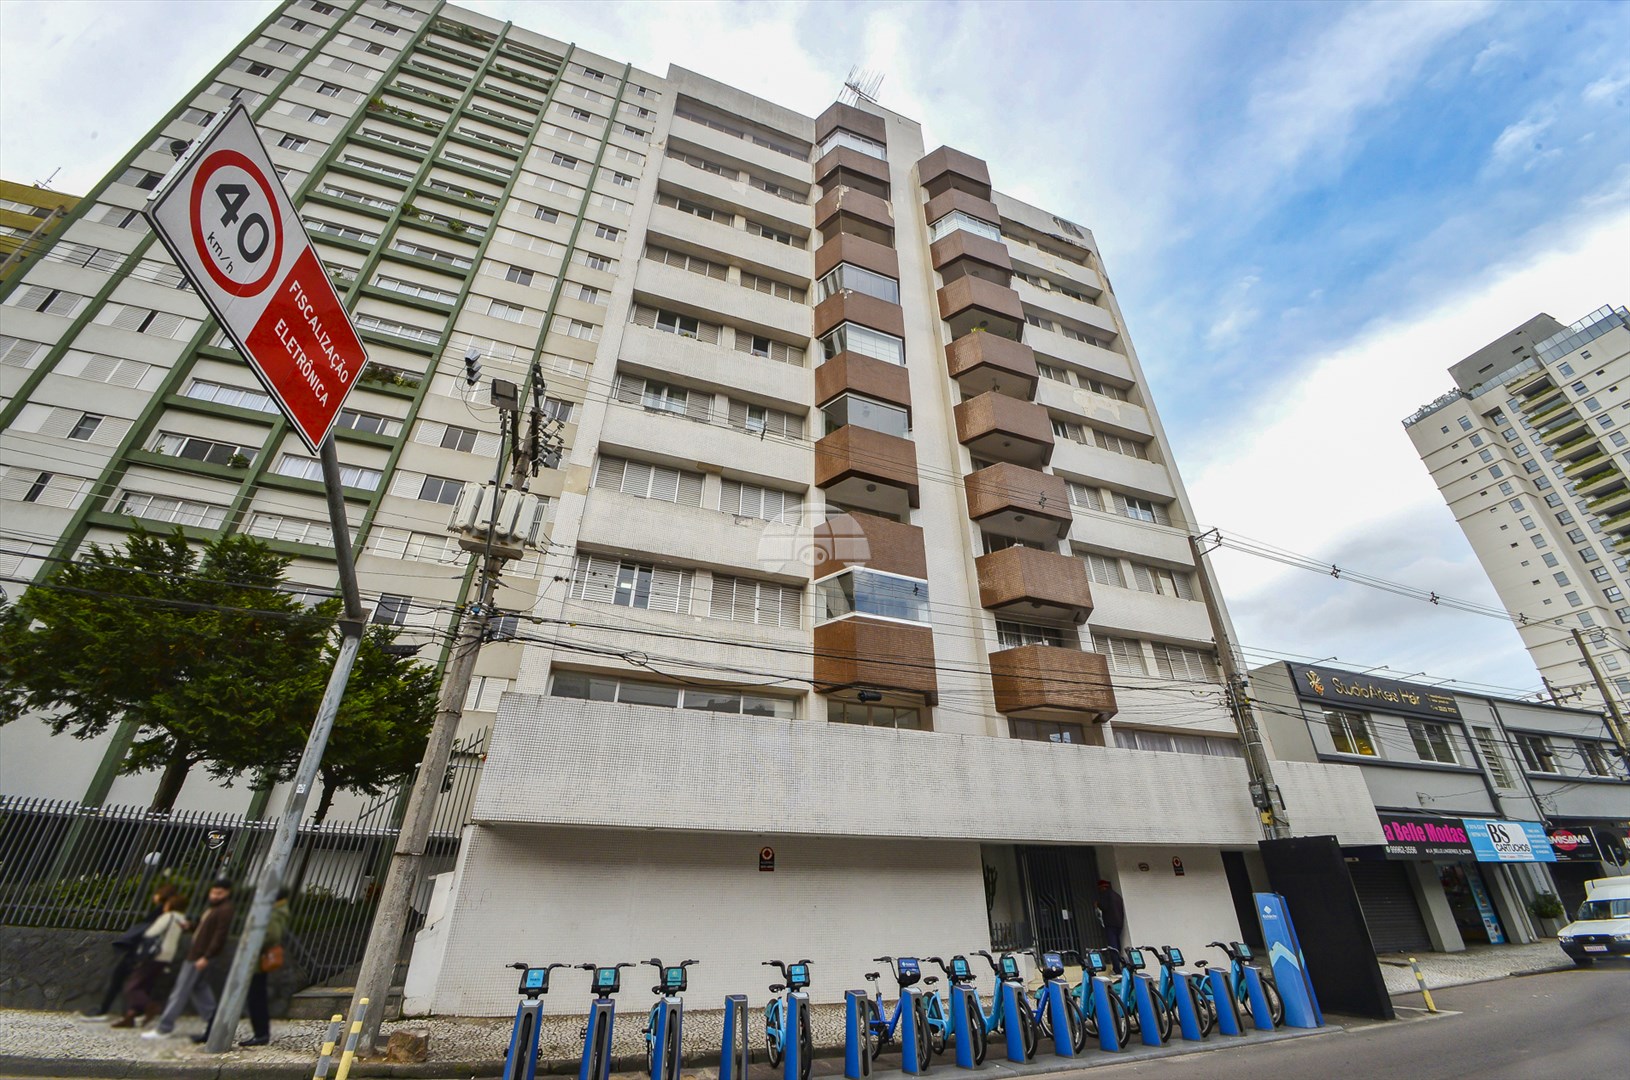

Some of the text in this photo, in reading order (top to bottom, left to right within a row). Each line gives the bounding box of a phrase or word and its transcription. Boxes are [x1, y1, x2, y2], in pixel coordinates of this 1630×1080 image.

[215, 183, 270, 263] 40
[207, 231, 234, 274] km/h
[289, 280, 349, 383] FISCALIZAÇÃO
[274, 318, 329, 407] ELETRÔNICA
[1391, 821, 1427, 842] Belle
[1423, 823, 1467, 843] Modas
[1486, 823, 1511, 843] BS
[1495, 843, 1531, 852] CARTUCHOS
